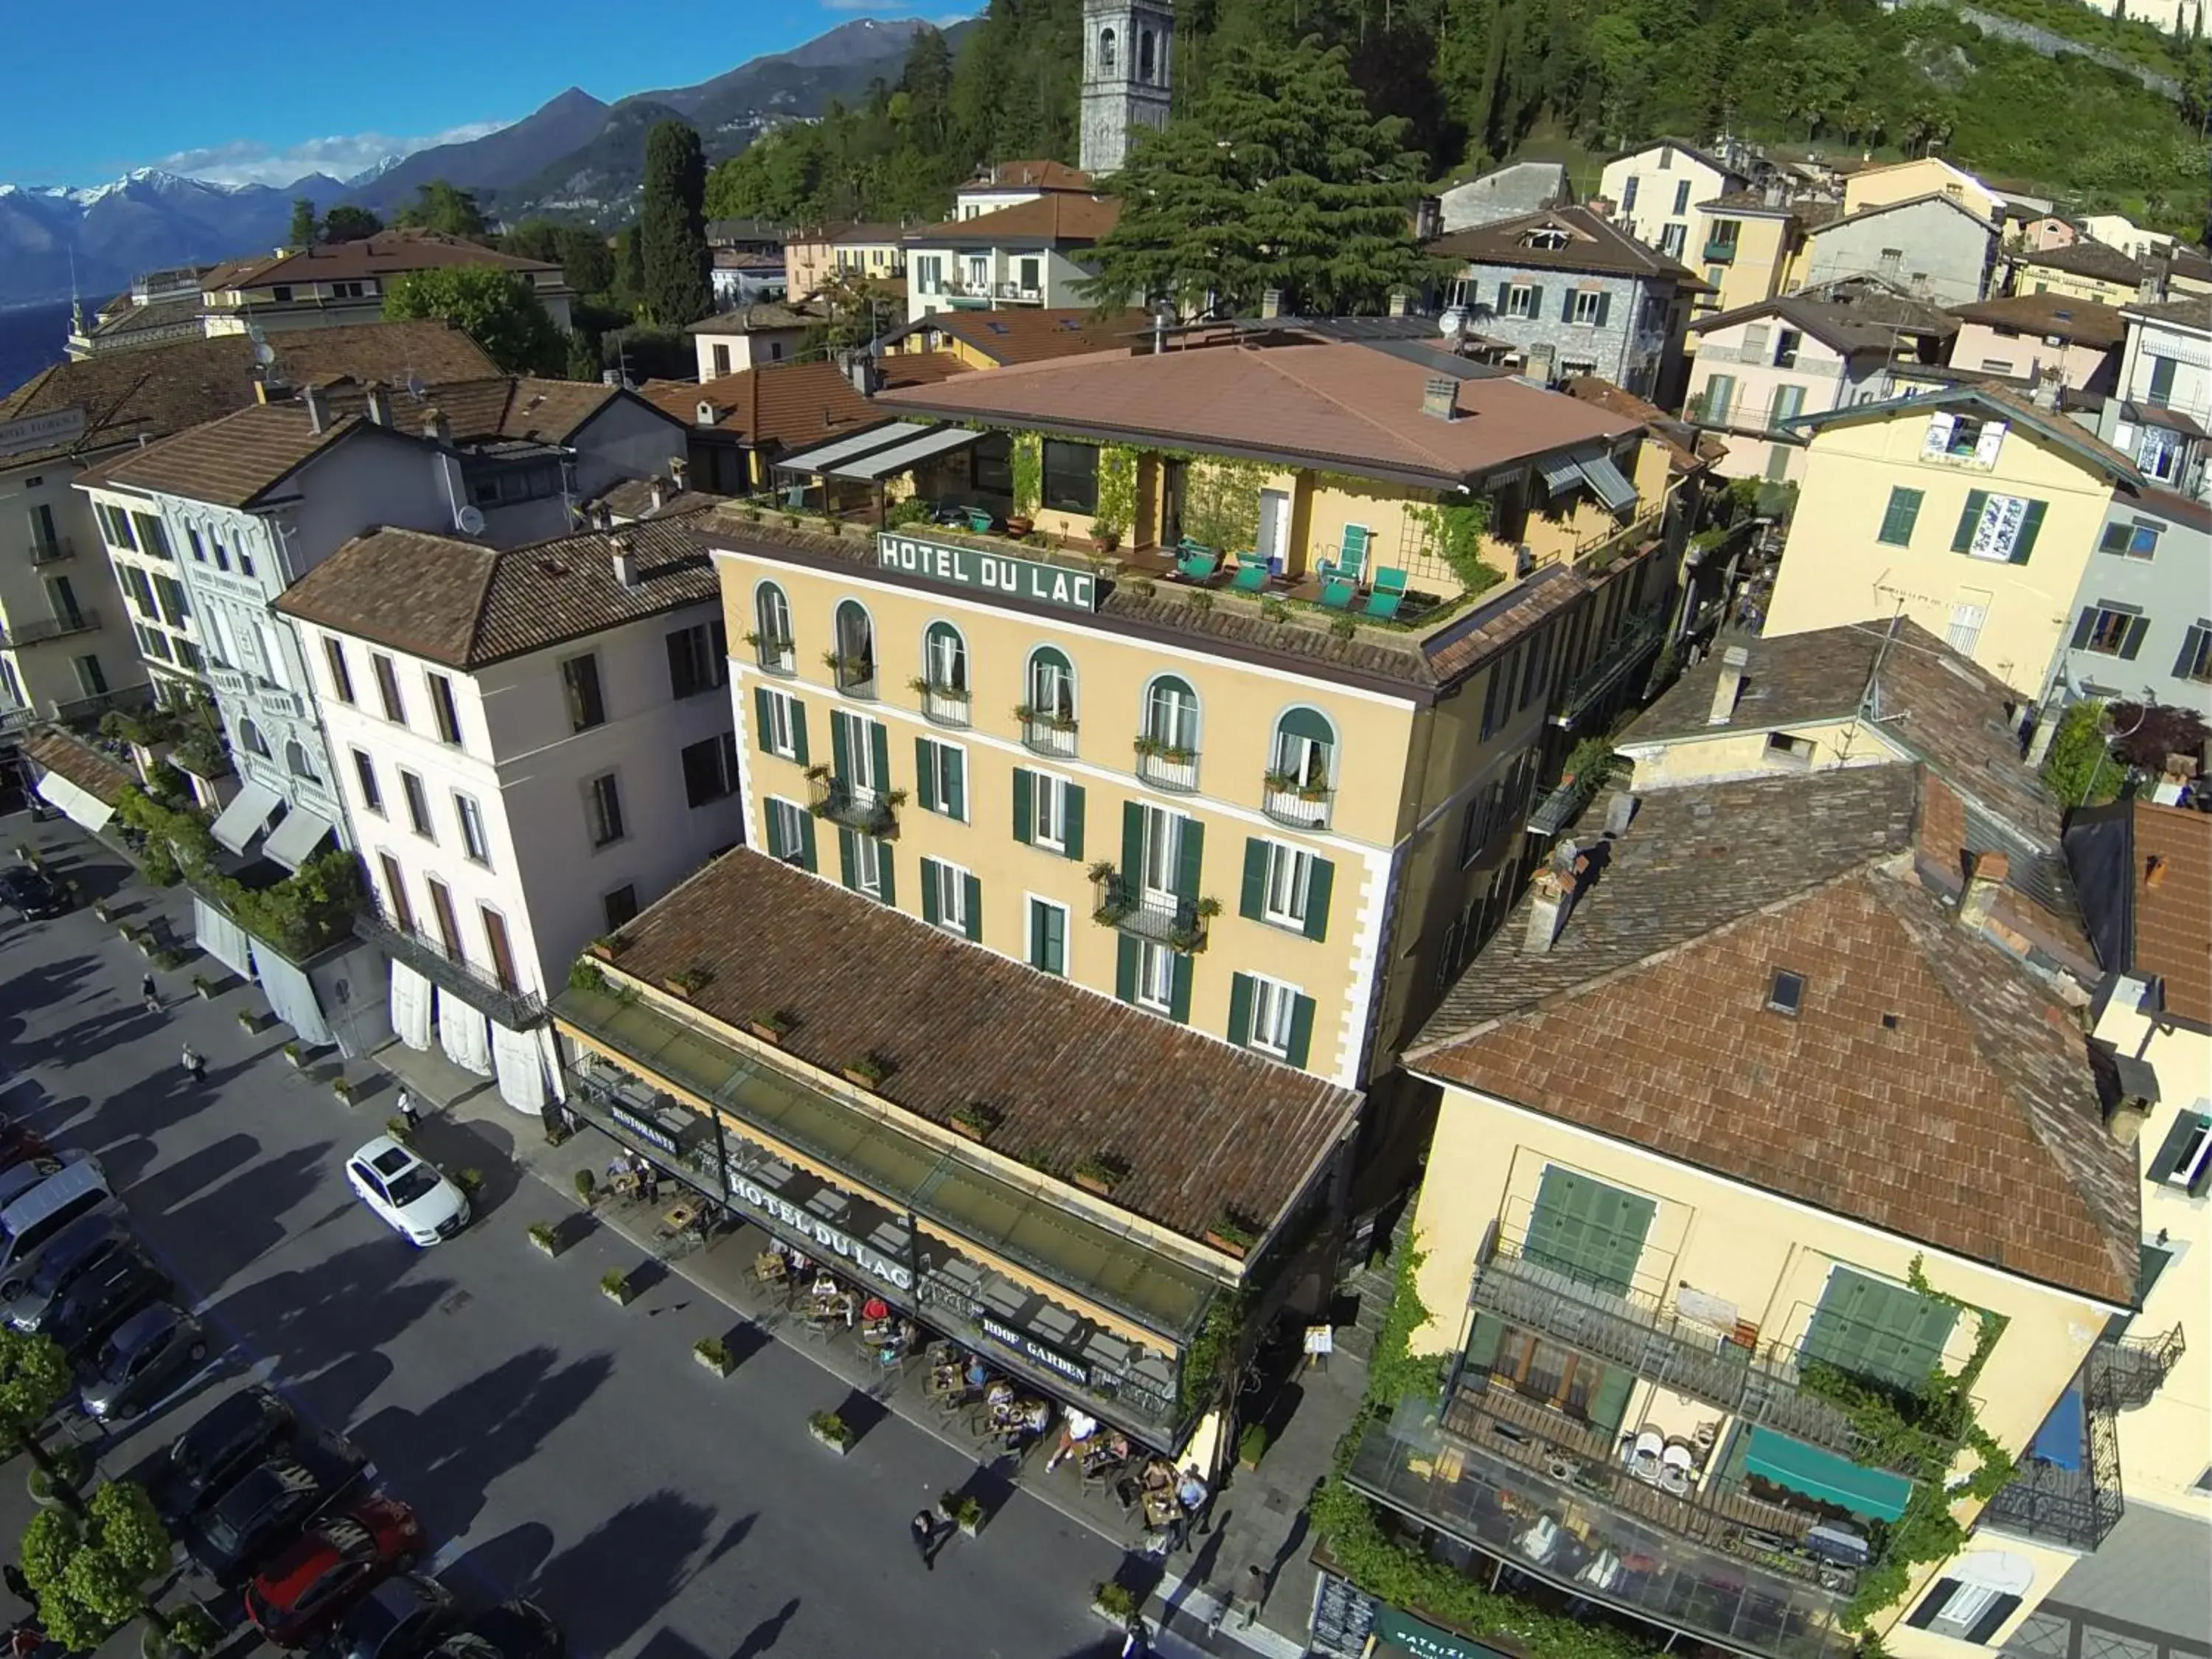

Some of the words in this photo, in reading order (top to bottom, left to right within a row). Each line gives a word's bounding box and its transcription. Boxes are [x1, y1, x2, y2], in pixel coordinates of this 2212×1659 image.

[882, 538, 969, 582] HOTEL
[981, 557, 1017, 592] DU
[1032, 568, 1091, 608] LAC
[613, 1107, 677, 1153] RISTORANTE
[728, 1172, 812, 1234] HOTEL
[815, 1225, 850, 1256] DU
[855, 1245, 912, 1290] LAC
[983, 1318, 1020, 1345] ROOF
[1026, 1341, 1088, 1383] GARDEN
